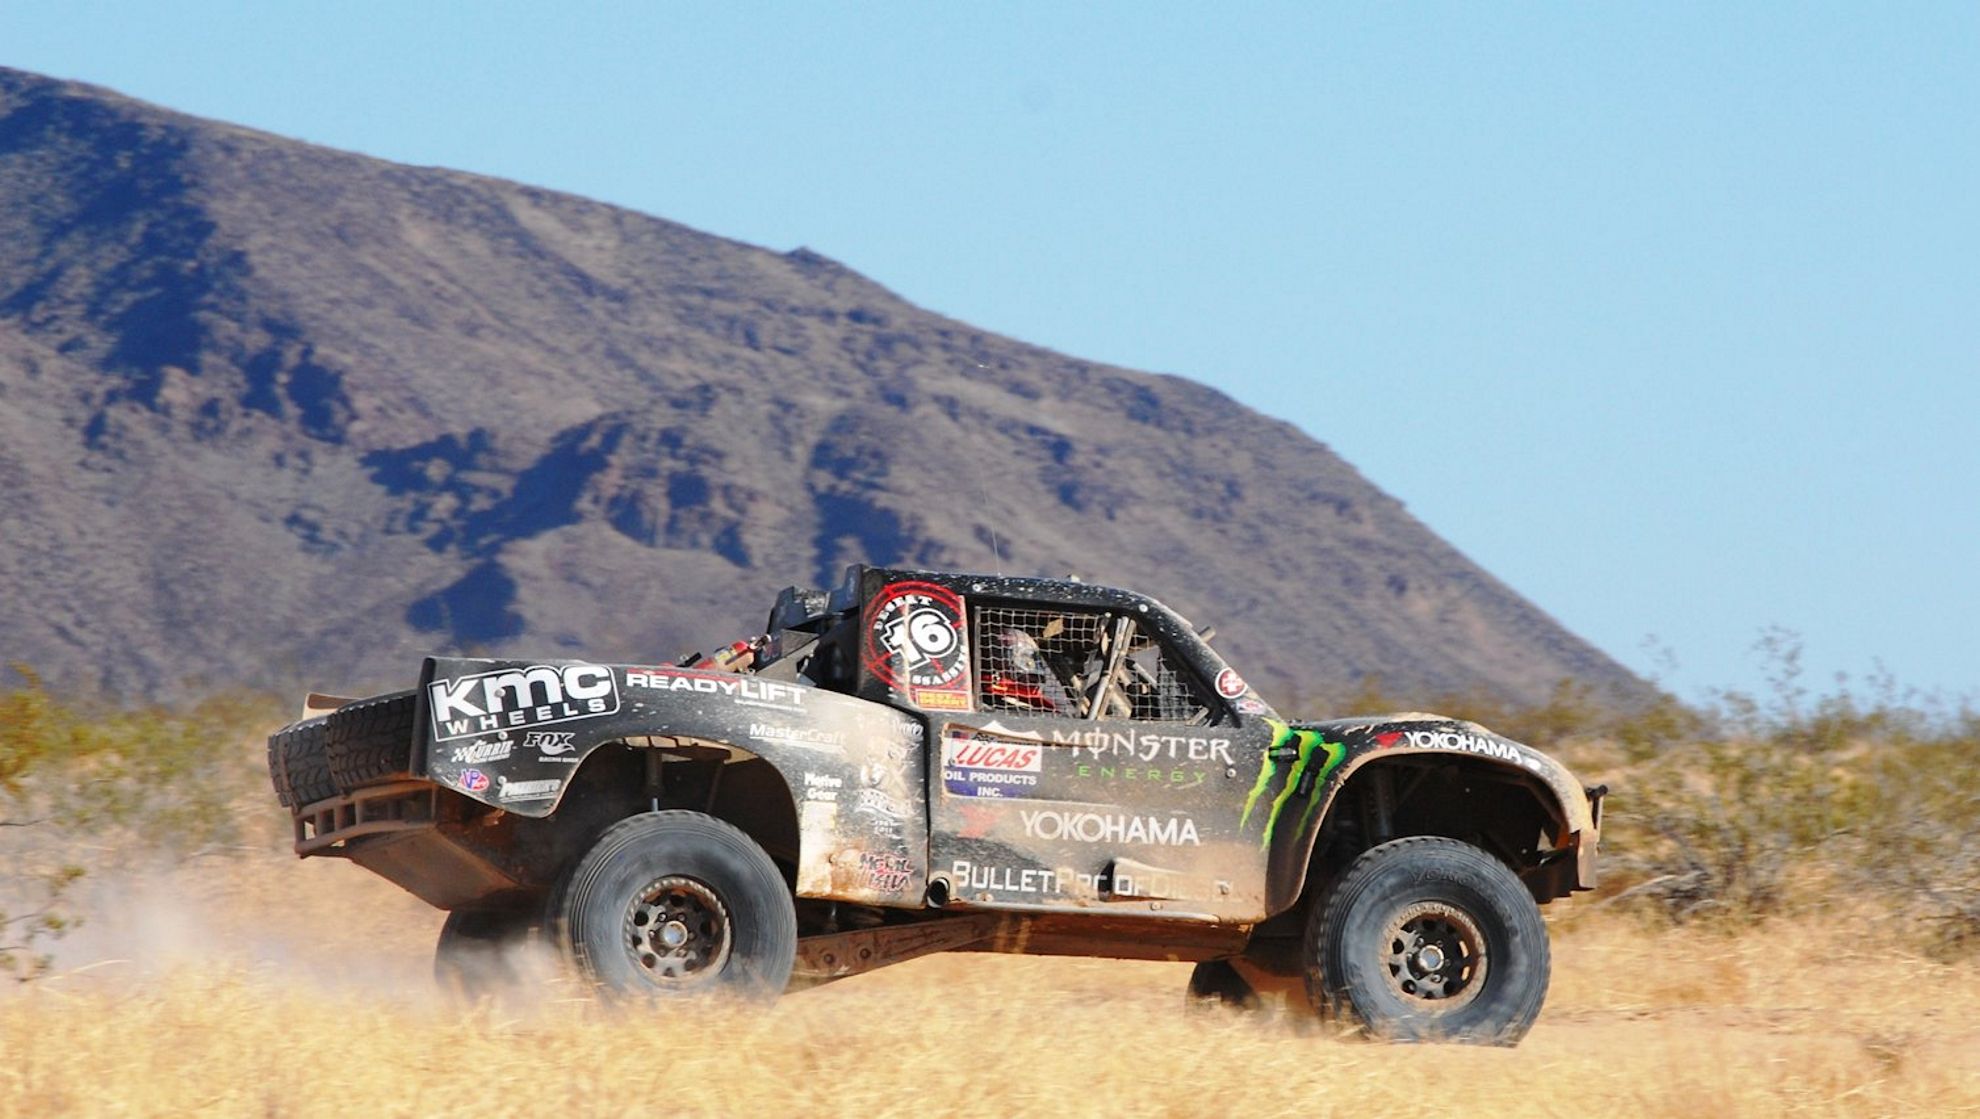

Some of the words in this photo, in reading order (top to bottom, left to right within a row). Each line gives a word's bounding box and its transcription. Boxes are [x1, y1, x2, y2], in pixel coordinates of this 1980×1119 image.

[881, 607, 957, 671] 16
[446, 698, 606, 735] WHEELS
[523, 731, 576, 756] FOX
[956, 744, 1038, 769] LUCAS
[1050, 727, 1236, 766] MONSTER
[1404, 731, 1523, 766] YOKOHAMA
[945, 770, 966, 781] OIL
[969, 771, 1038, 786] PRODUCTS
[1078, 763, 1207, 783] ENERGY
[976, 786, 1004, 798] INC.
[1020, 809, 1200, 847] YOKOHAMA
